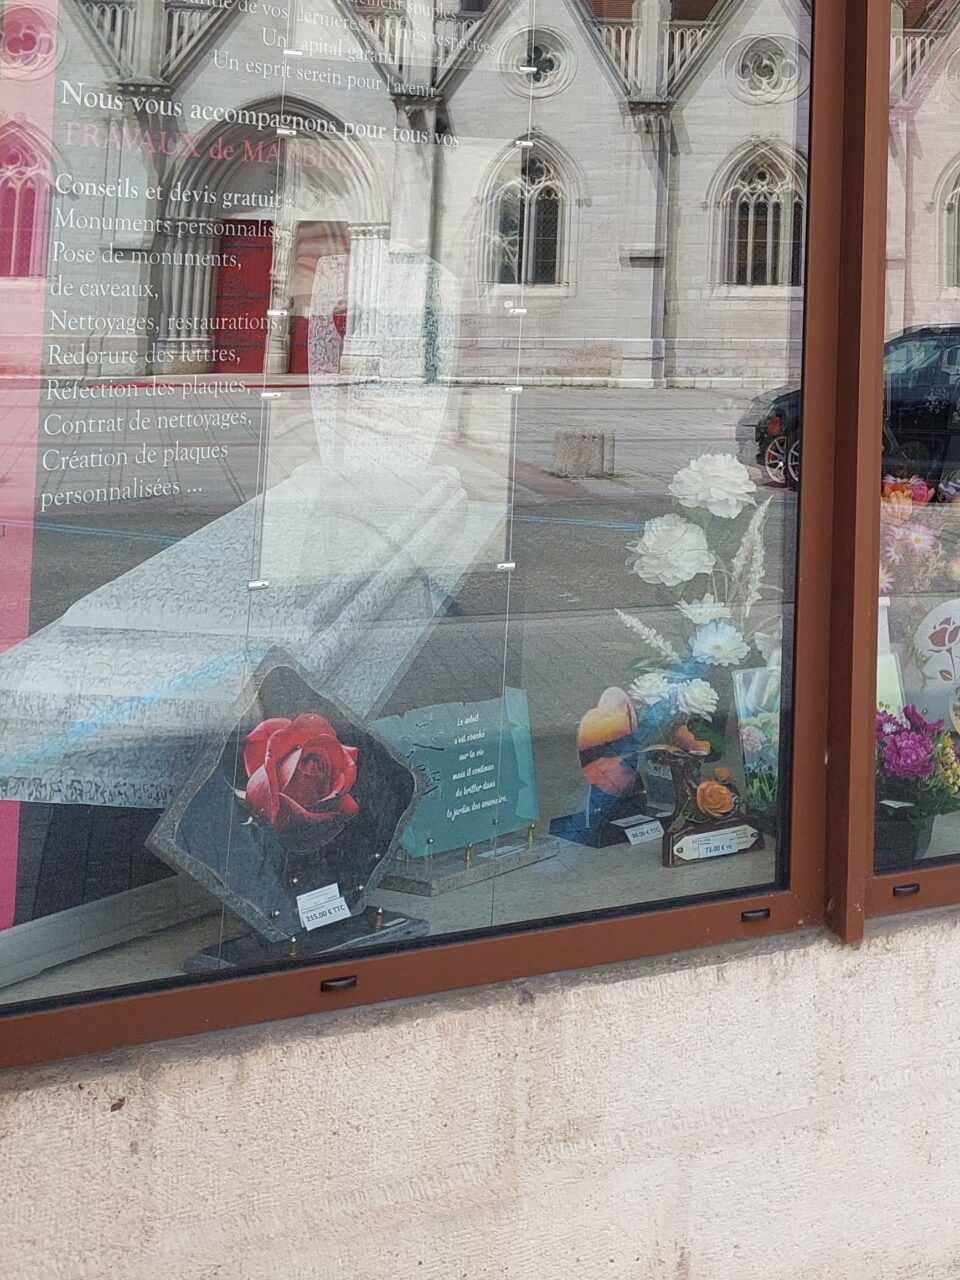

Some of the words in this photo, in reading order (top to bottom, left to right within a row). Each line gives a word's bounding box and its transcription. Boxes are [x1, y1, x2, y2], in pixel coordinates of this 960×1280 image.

[262, 4, 288, 19] vos
[262, 26, 288, 48] Un
[299, 37, 343, 57] apital
[213, 49, 240, 71] Un
[245, 60, 292, 79] esprit
[296, 66, 343, 85] serein
[347, 74, 383, 91] pour
[60, 79, 124, 112] Nous
[131, 96, 183, 118] vous
[190, 104, 338, 136] accompagnons
[343, 121, 387, 141] pour
[392, 126, 429, 145] tous
[434, 131, 461, 149] vos
[59, 120, 201, 158] TRAVAUX
[209, 136, 235, 161] de
[54, 172, 139, 200] Conseils
[144, 184, 164, 201] et
[169, 181, 218, 204] devis
[53, 207, 172, 234] Monuments
[51, 240, 97, 264] Pose
[101, 242, 127, 265] de
[130, 250, 243, 271] monuments,
[49, 275, 74, 297] de
[79, 282, 159, 301] caveaux,
[49, 308, 160, 335] Nettoyages,
[167, 312, 283, 333] restaurations,
[47, 342, 139, 366] Redorure
[144, 342, 175, 364] des
[181, 342, 242, 365] lettres,
[46, 377, 139, 401] Réfection
[144, 375, 175, 397] des
[181, 374, 251, 400] plaques,
[43, 413, 124, 436] Contrat
[128, 409, 151, 432] de
[156, 409, 252, 433] nettoyages,
[42, 447, 129, 471] Création
[134, 441, 157, 465] de
[162, 440, 229, 467] plaques
[39, 477, 181, 513] personnalisées
